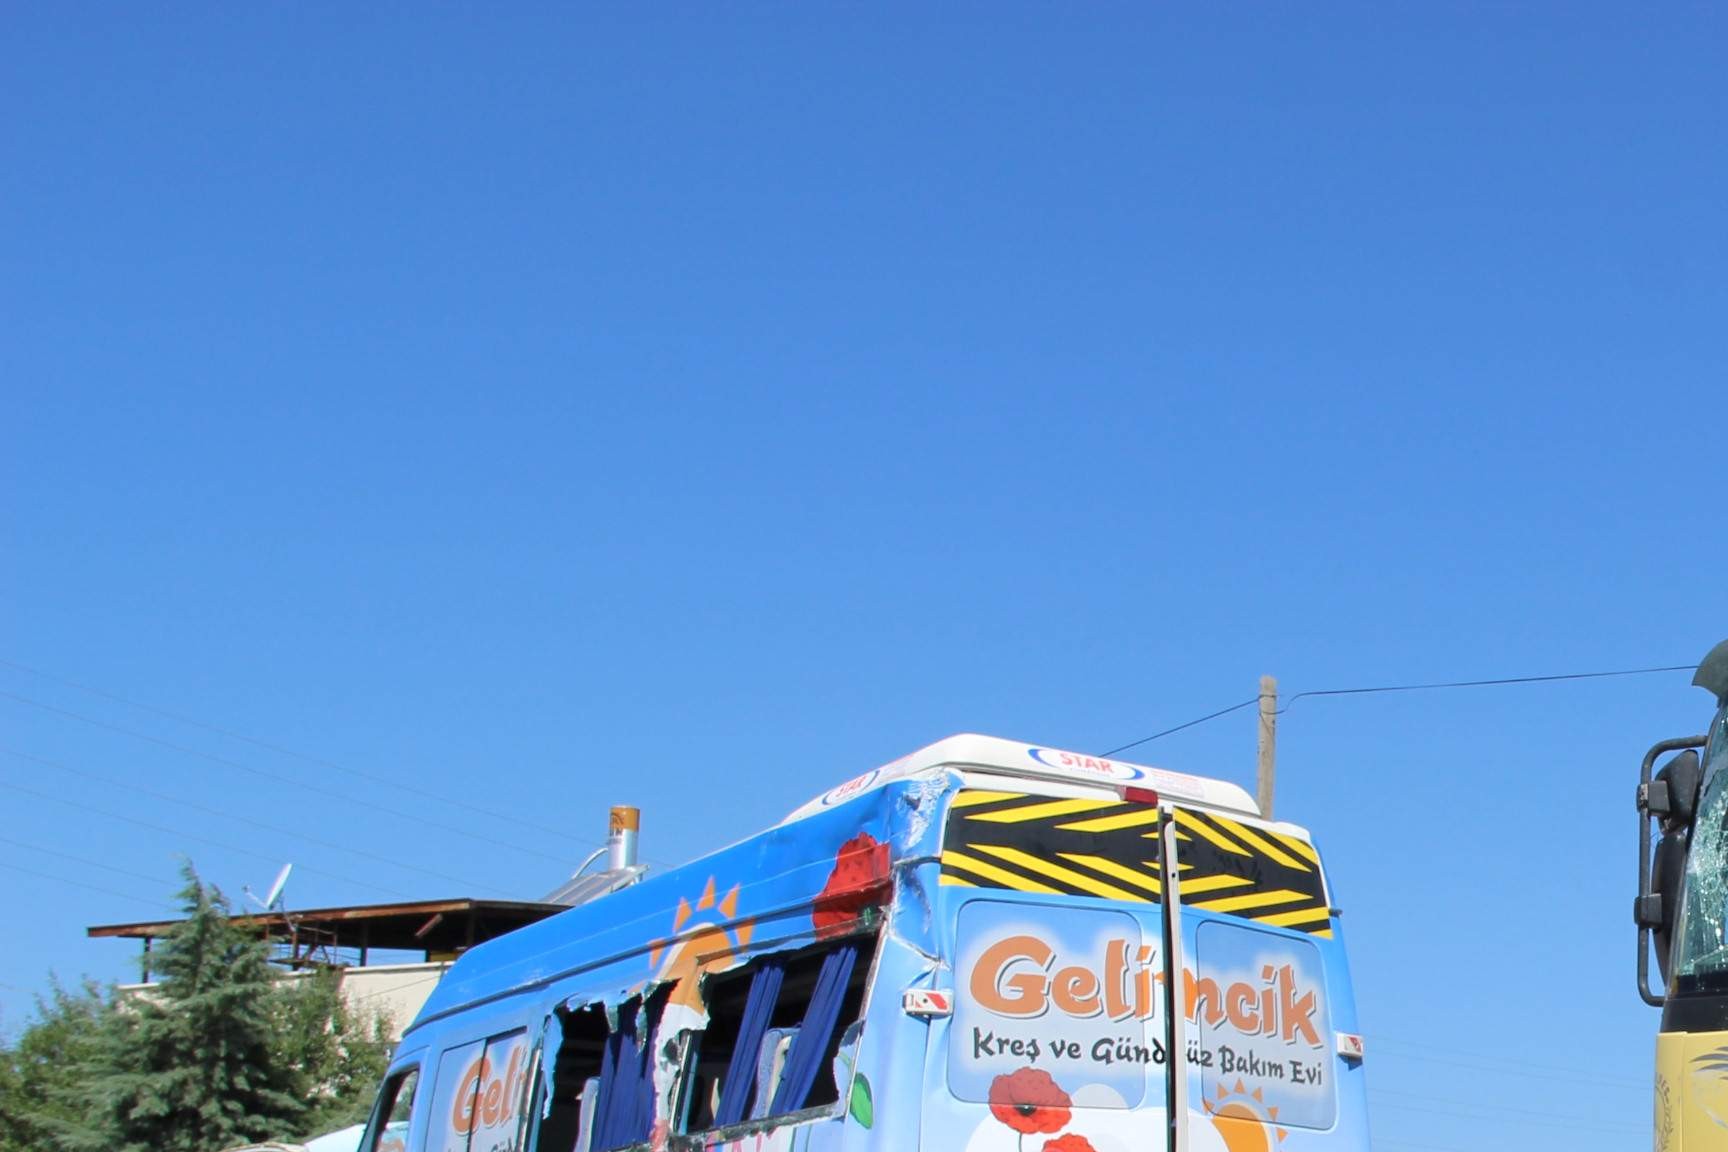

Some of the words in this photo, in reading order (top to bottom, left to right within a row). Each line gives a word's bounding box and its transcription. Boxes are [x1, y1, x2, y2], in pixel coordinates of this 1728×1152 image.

[1059, 752, 1113, 773] STAR
[973, 1026, 1042, 1063] Kreş
[1048, 1040, 1082, 1060] ve
[1218, 1048, 1284, 1080] Bakım
[1289, 1059, 1323, 1086] Evi
